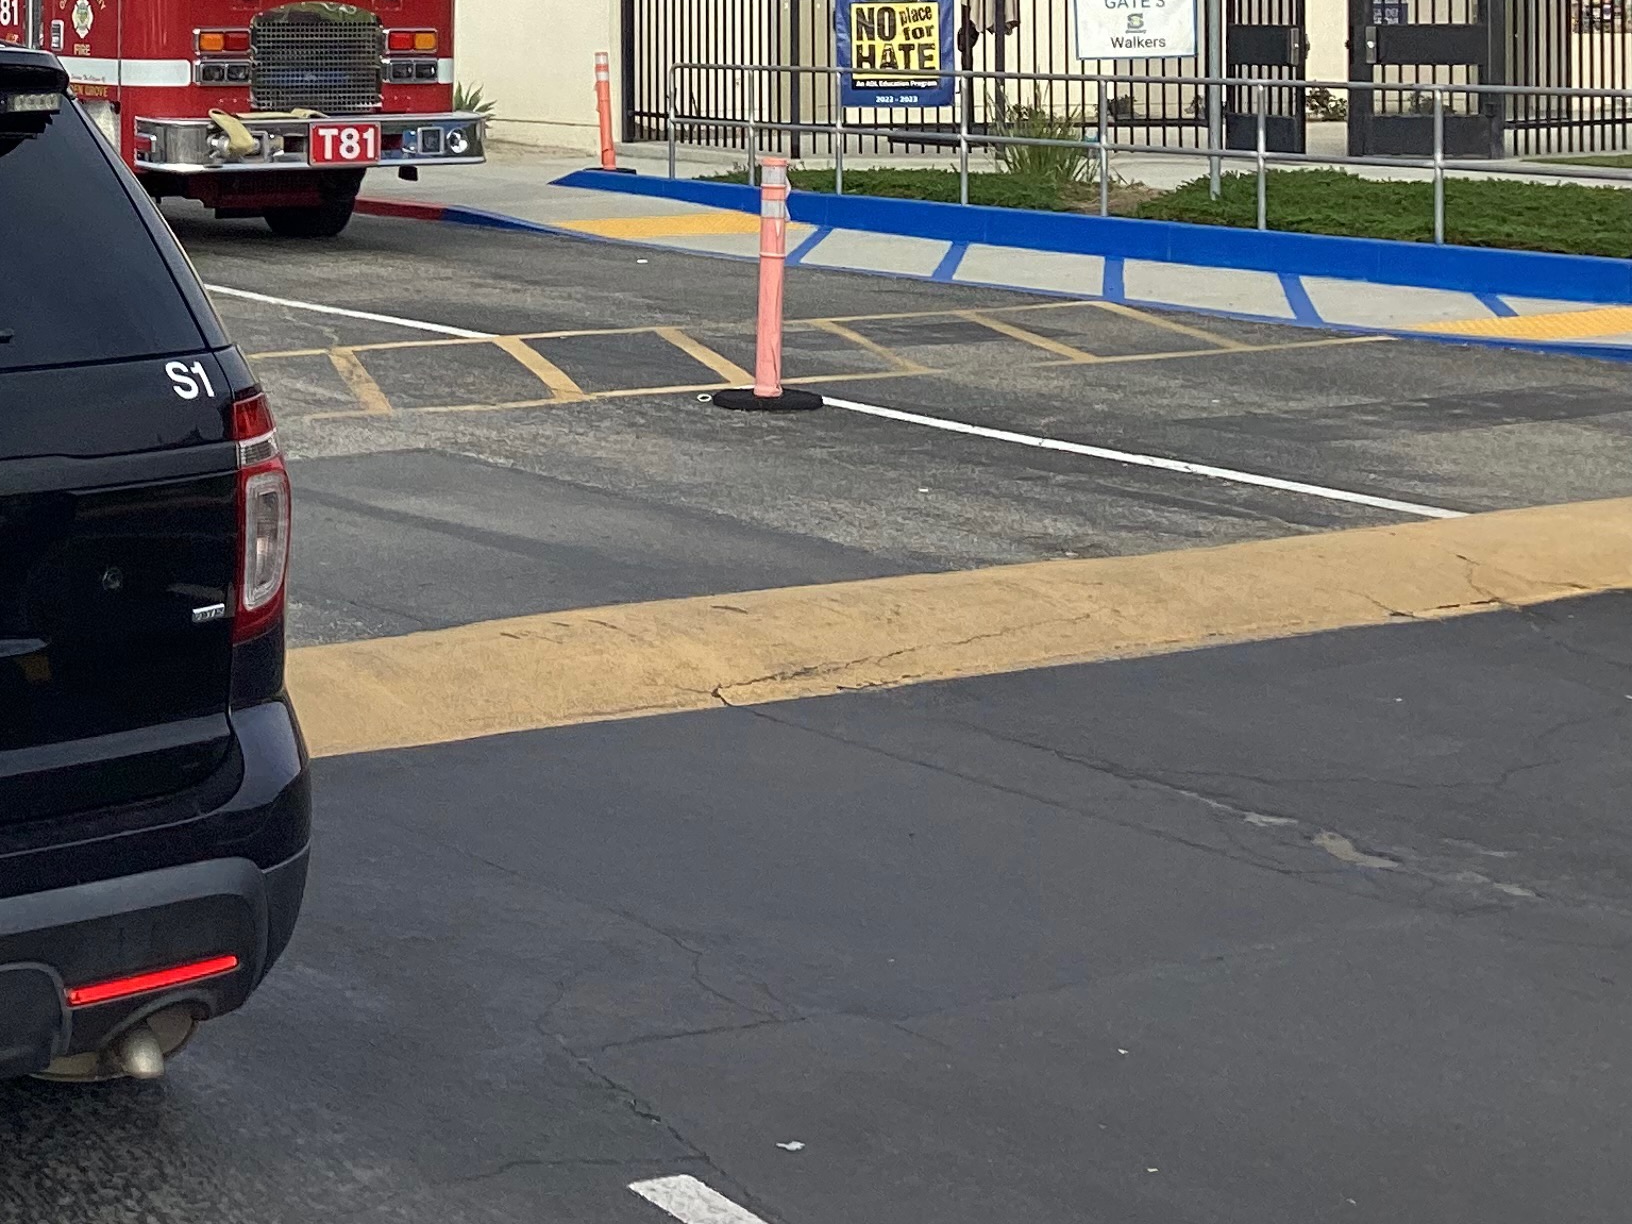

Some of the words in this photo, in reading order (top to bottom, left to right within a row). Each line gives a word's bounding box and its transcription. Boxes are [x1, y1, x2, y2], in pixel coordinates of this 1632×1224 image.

[856, 6, 896, 41] NO
[899, 6, 932, 27] place
[903, 25, 934, 41] for
[74, 43, 91, 56] FIRE
[1110, 36, 1166, 49] Walkers
[856, 43, 936, 70] HATE
[318, 127, 375, 160] T81
[165, 360, 215, 400] S1
